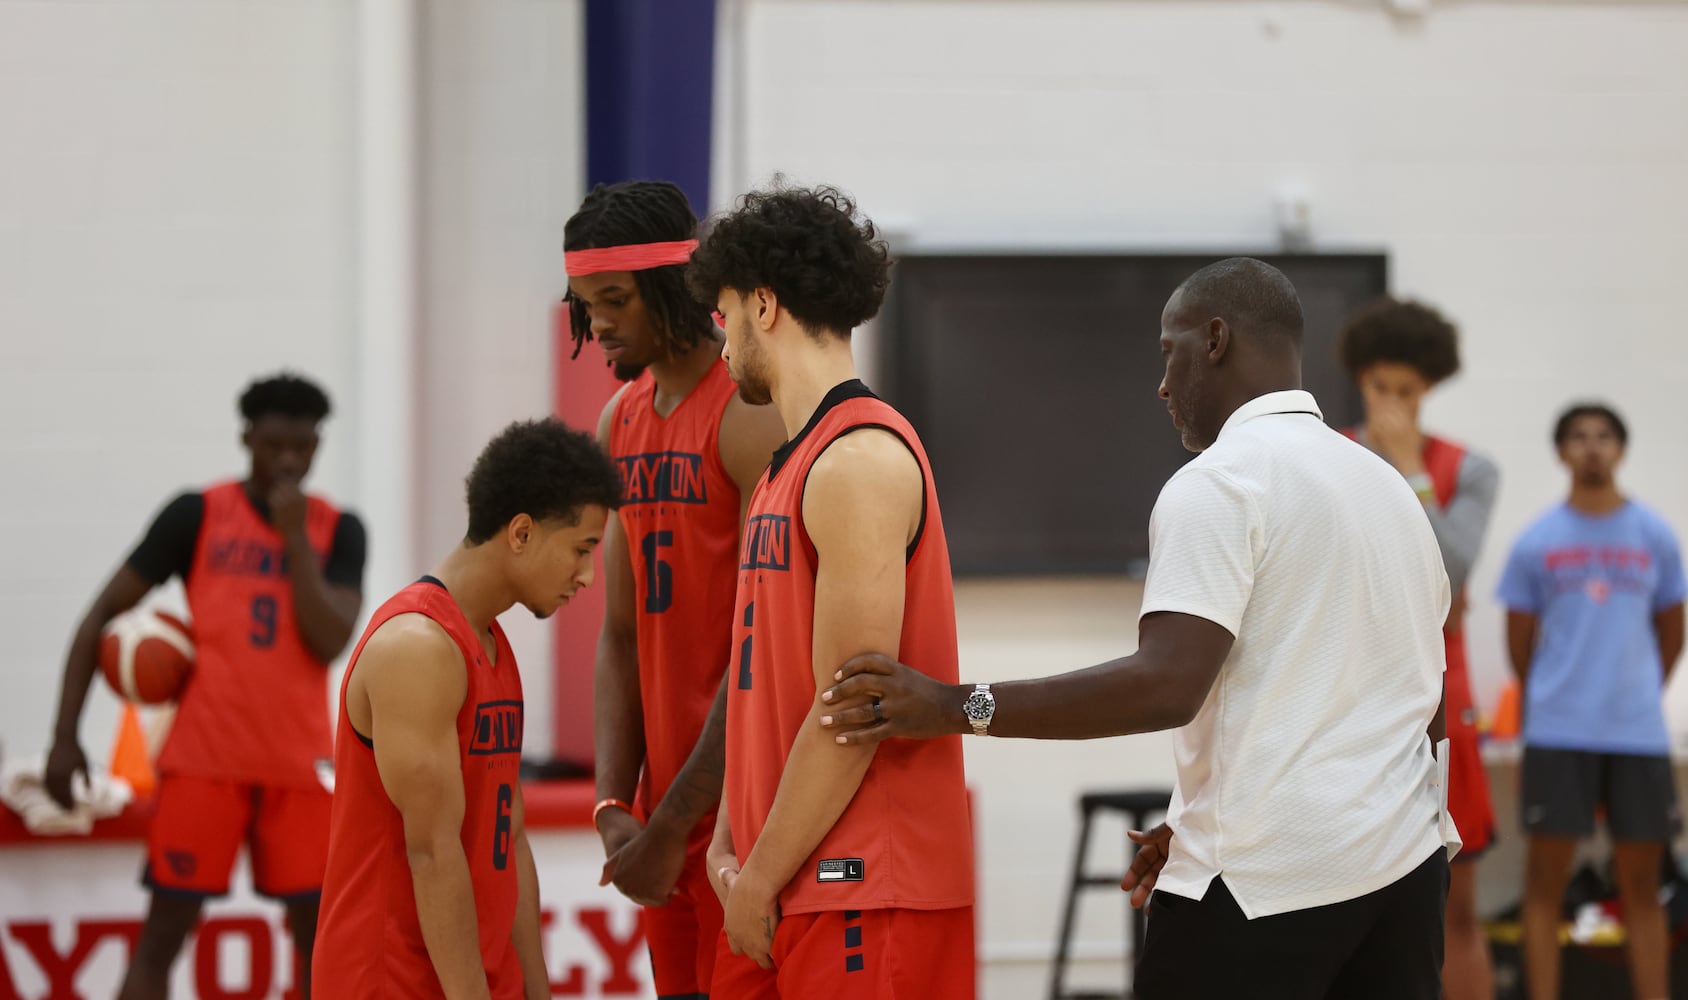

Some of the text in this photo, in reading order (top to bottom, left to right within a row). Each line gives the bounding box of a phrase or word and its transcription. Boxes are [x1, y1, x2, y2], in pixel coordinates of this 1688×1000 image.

[250, 594, 278, 650] 9
[492, 783, 513, 871] 6
[849, 865, 857, 875] L
